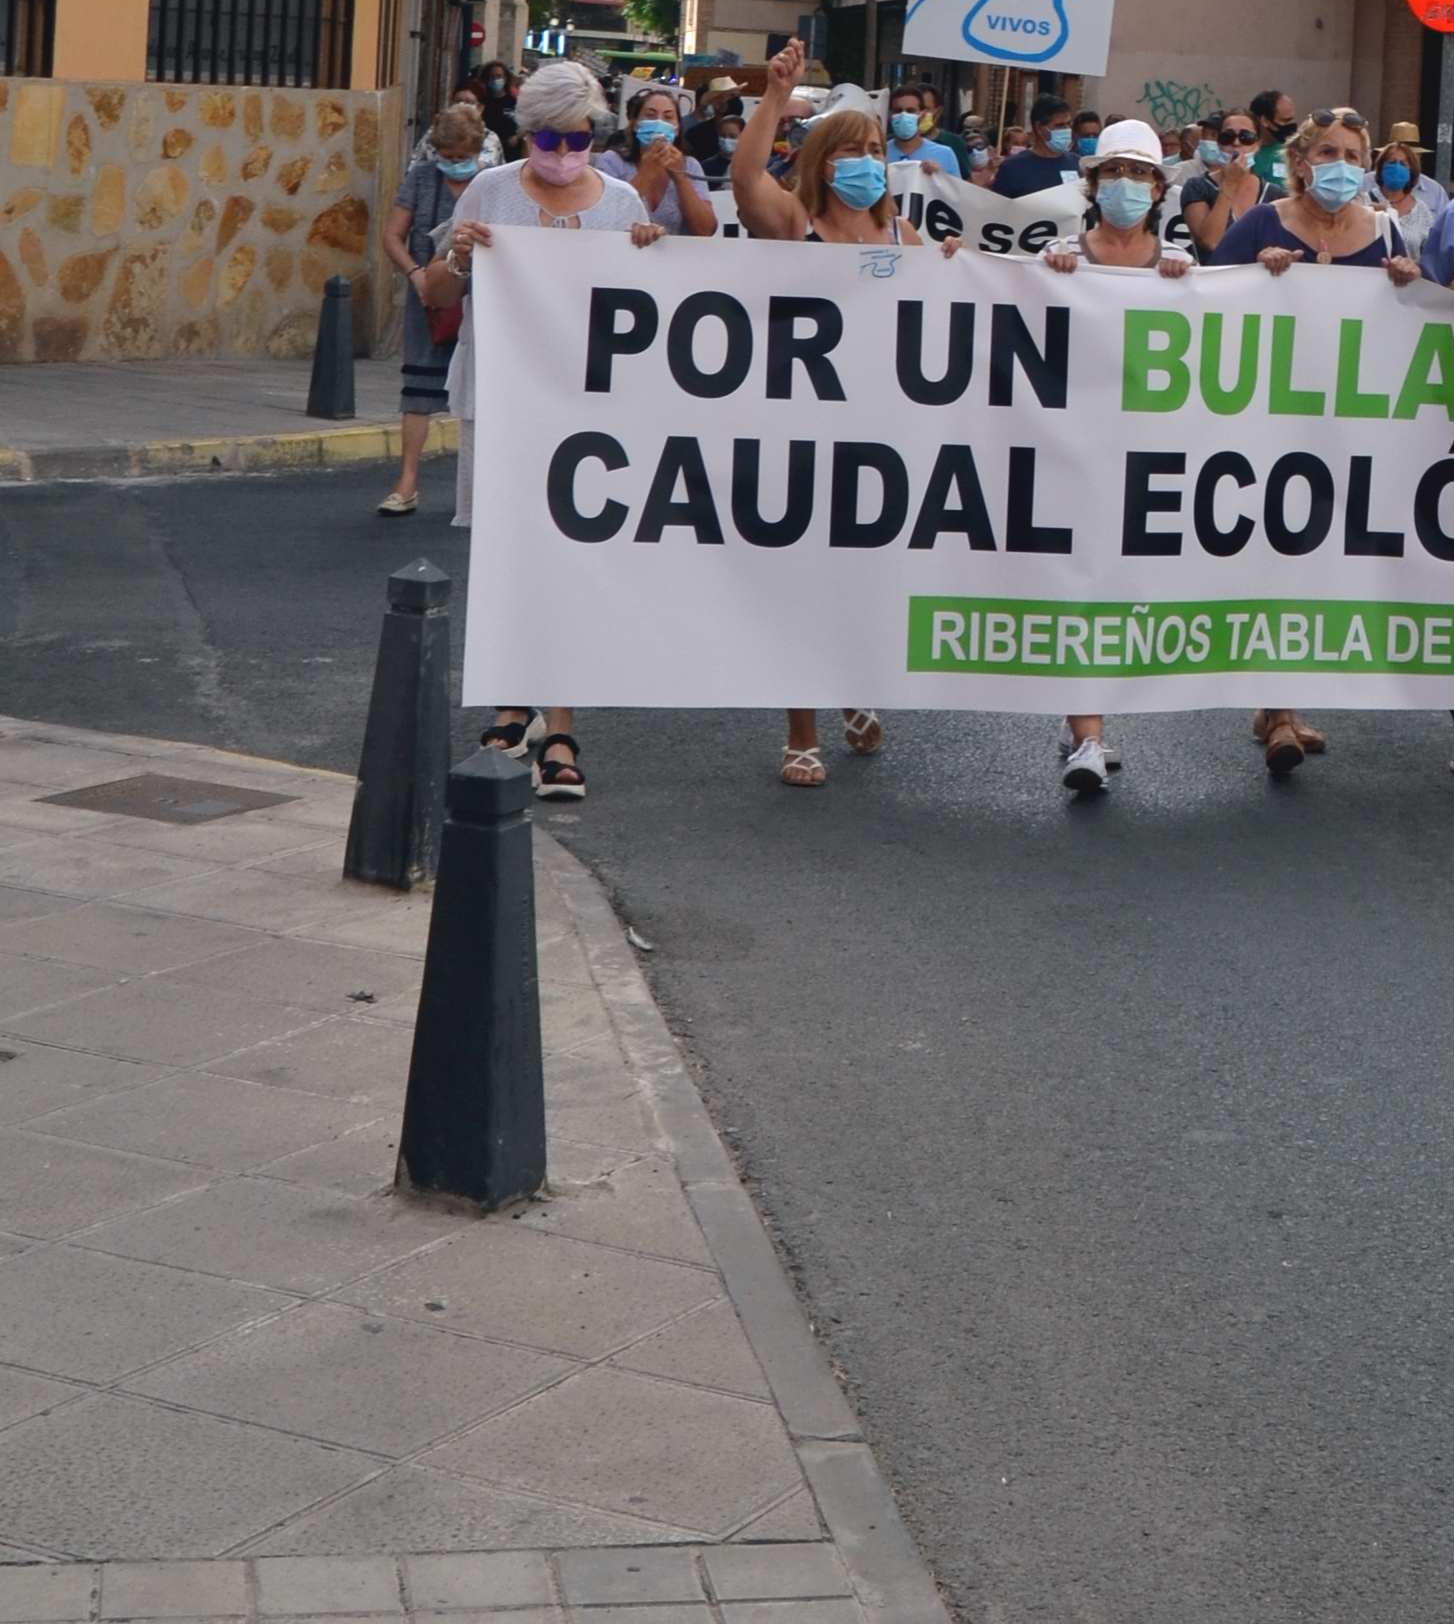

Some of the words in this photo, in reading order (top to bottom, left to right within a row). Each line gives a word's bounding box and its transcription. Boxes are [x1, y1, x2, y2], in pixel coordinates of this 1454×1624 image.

[986, 14, 1051, 36] VIVOS
[979, 220, 1058, 254] se
[585, 288, 847, 402] POR
[896, 301, 1071, 409] UN
[547, 431, 1073, 555] CAUDAL
[932, 604, 1213, 666] RIBEREÑOS
[1225, 612, 1374, 663] TABLA
[1387, 615, 1453, 664] DE
